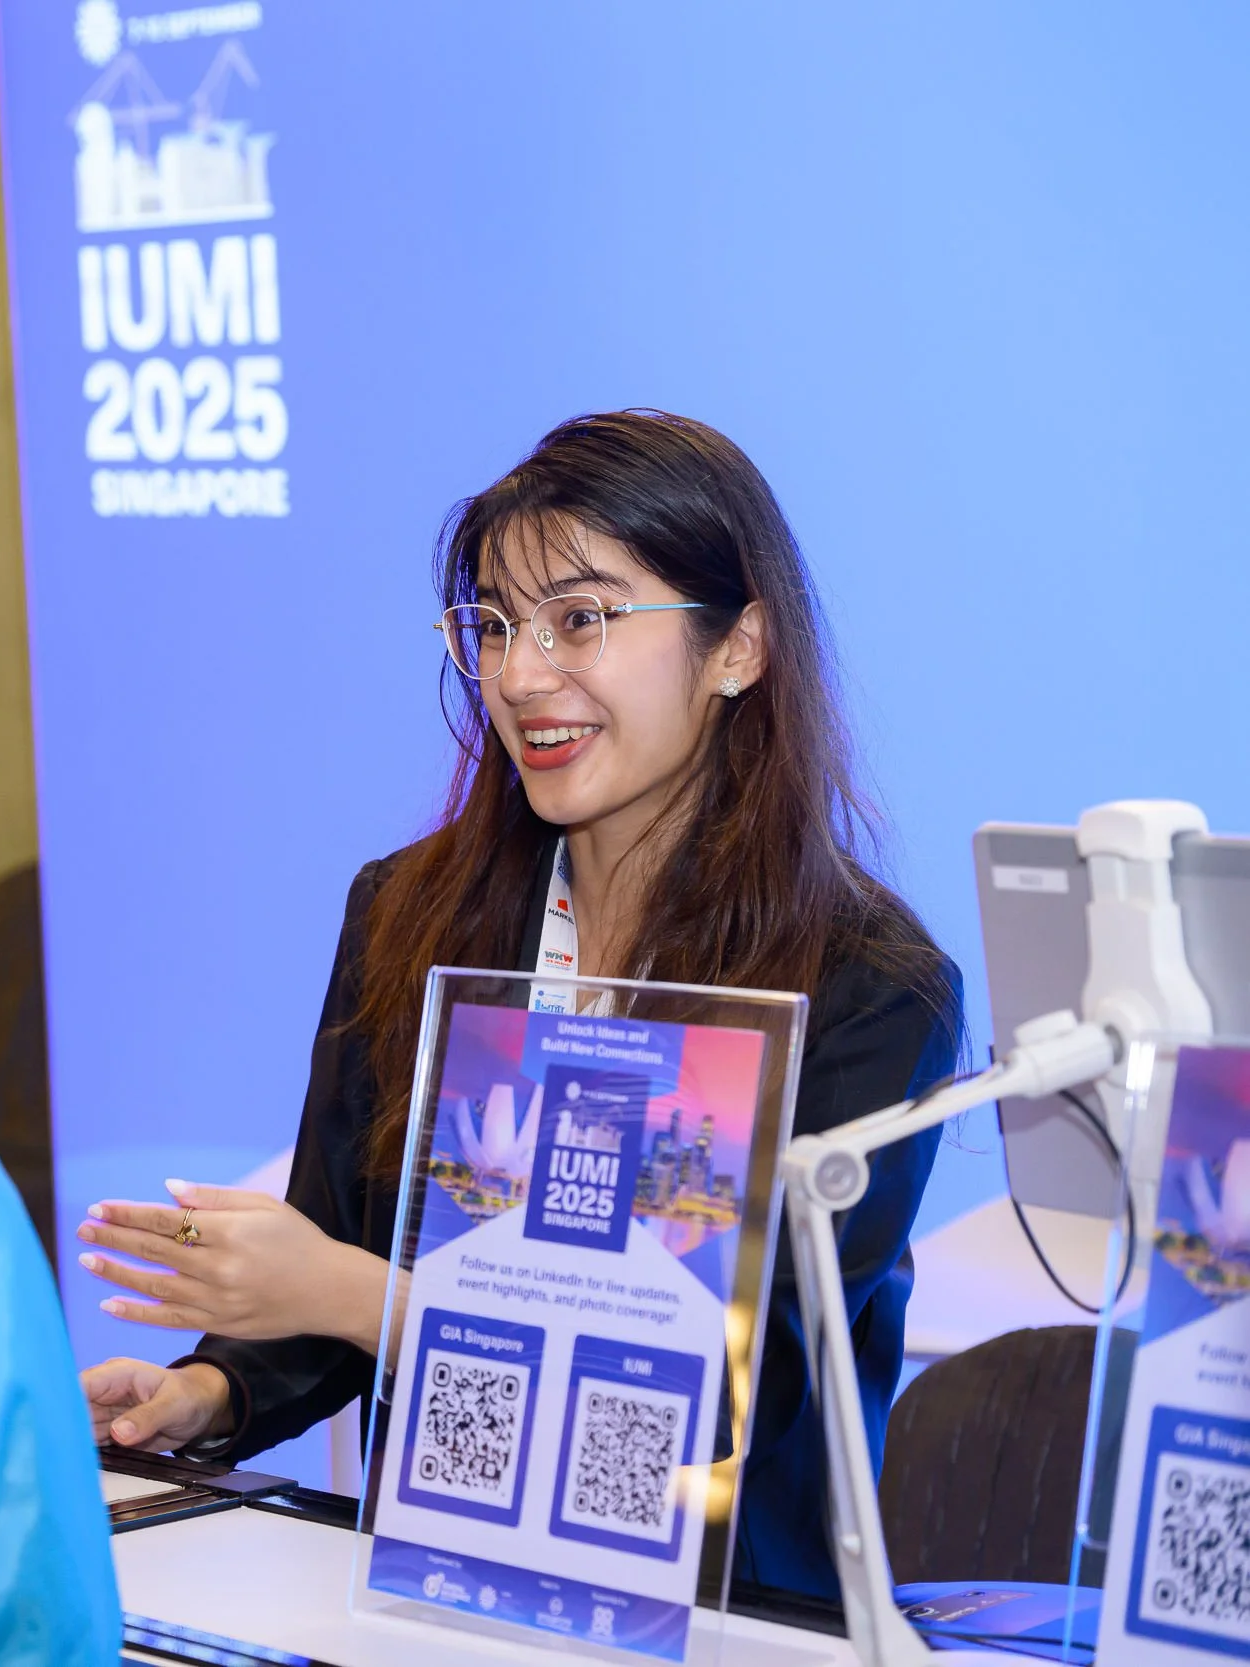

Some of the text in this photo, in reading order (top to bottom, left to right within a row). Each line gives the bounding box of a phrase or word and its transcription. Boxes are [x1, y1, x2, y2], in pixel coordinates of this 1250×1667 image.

[78, 233, 281, 352] IUMI
[84, 355, 288, 462] 2025
[91, 467, 290, 518] SINGAPORE
[548, 908, 574, 925] MARKEL
[541, 1037, 663, 1065] Build New Connections
[557, 1021, 595, 1037] Unlock
[627, 1030, 649, 1044] and
[549, 1149, 620, 1187] IUMI
[544, 1180, 616, 1218] 2025
[542, 1211, 612, 1234] SINGAPORE
[460, 1255, 496, 1272] Follow
[501, 1265, 513, 1276] us
[517, 1267, 531, 1278] on
[534, 1268, 583, 1288] LinkedIn
[587, 1276, 603, 1291] for
[606, 1279, 626, 1294] live
[458, 1277, 488, 1293] event
[554, 1292, 576, 1308] and
[579, 1297, 612, 1314] photo
[439, 1324, 524, 1352] GIA Singapore
[622, 1357, 653, 1376] IUMI
